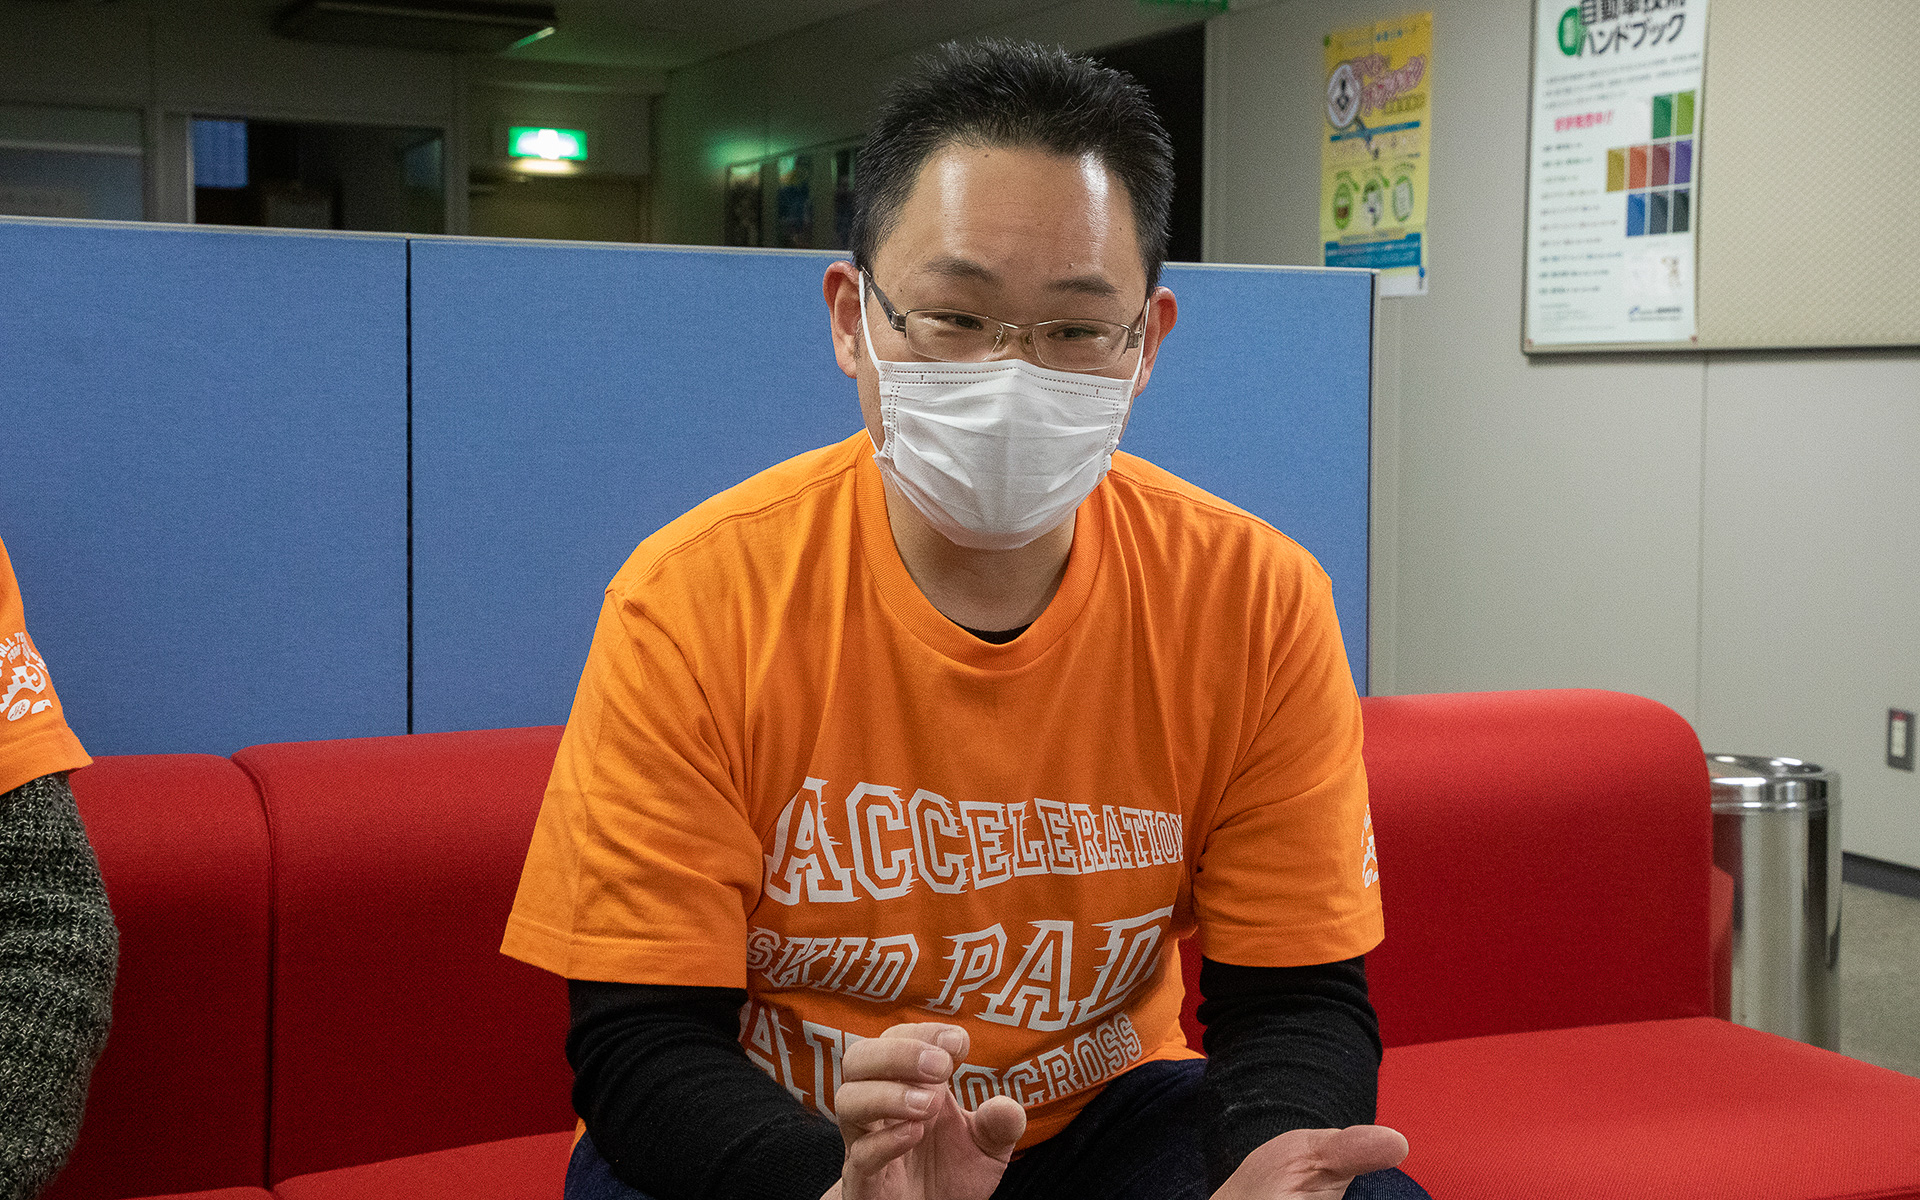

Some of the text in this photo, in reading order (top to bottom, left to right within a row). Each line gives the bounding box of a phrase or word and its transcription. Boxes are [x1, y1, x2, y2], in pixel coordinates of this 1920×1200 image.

[1579, 13, 1686, 57] ハンドブック
[763, 776, 1183, 906] ACCELERATION
[746, 904, 1175, 1033] SKID PAD
[738, 1000, 1143, 1122] AUOCROSS
